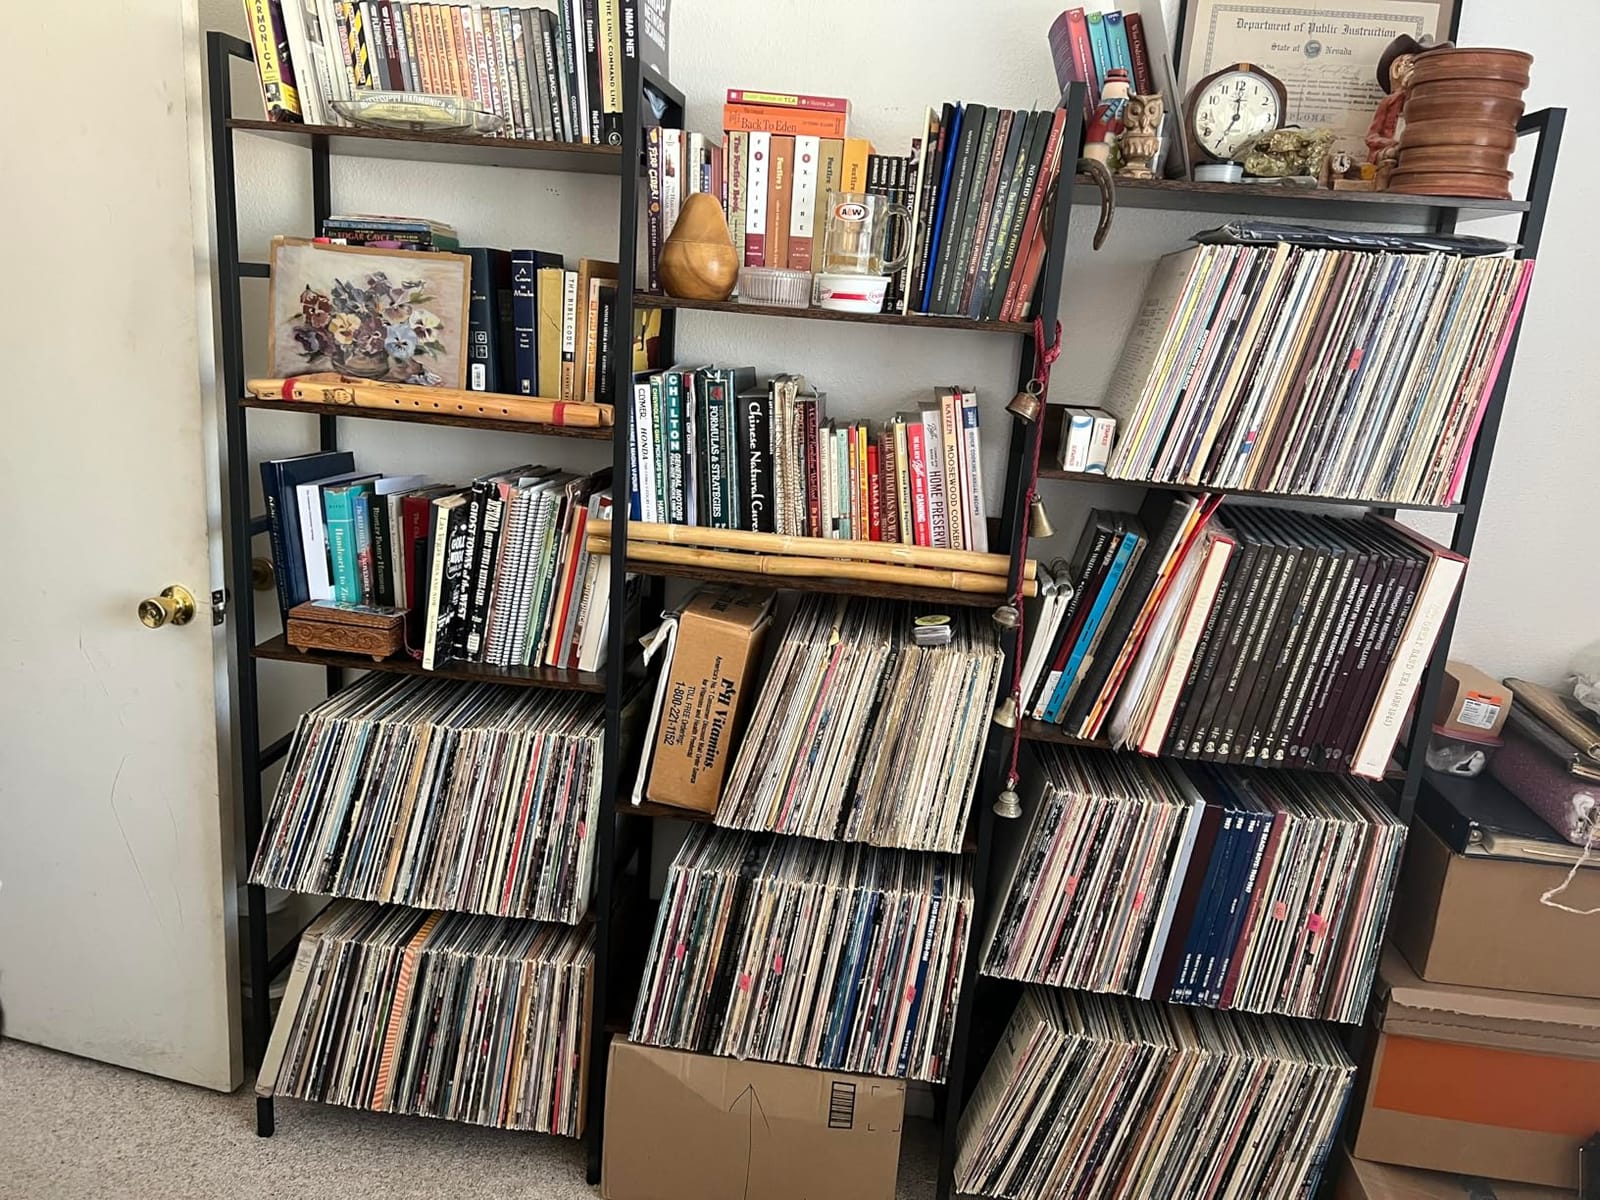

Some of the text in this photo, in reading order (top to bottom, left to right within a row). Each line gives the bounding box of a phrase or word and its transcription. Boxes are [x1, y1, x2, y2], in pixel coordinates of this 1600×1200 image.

[585, 19, 595, 52] Essentials
[624, 7, 634, 37] NMAP
[1236, 17, 1396, 38] Department of Public Instruction
[1271, 42, 1291, 52] State
[1325, 46, 1352, 56] Nevada
[607, 45, 615, 87] COMMAND
[1235, 80, 1246, 92] 12
[741, 118, 761, 129] Back
[776, 121, 797, 133] Eden
[999, 179, 1008, 193] The
[1003, 163, 1035, 269] NO GRID SURVIVAL PROJECTS
[979, 240, 993, 271] Backyard
[637, 388, 648, 460] CLYMER HONDA
[668, 375, 682, 450] CHILTON
[748, 401, 763, 449] Chinese
[709, 405, 719, 454] FORMULAS
[884, 437, 894, 453] THE
[944, 403, 959, 507] KATZEN MOOSEWOOD
[673, 452, 683, 521] GENERAL MOTORS
[711, 463, 721, 517] STRATEGIES
[749, 450, 764, 498] Natural
[886, 472, 896, 492] THAT
[928, 470, 942, 497] HOME
[482, 498, 500, 532] NEVADA
[887, 492, 897, 511] HAS
[916, 493, 926, 522] CANNING
[462, 536, 475, 569] TOWNS
[456, 592, 468, 620] WEST
[1365, 583, 1383, 617] NASHVILLE
[1387, 584, 1405, 615] MIDNIGHT
[1393, 590, 1415, 637] FOR THE GOOD
[1321, 577, 1360, 668] SMOKEY MOUNTAIN MEMORIES
[1336, 583, 1368, 656] TWILIGHT IN TENNESSEE
[1373, 621, 1389, 650] MEMPHIS
[1355, 621, 1379, 671] HANK WILLIAMS
[685, 684, 696, 702] TOLL
[682, 702, 692, 719] FREE
[703, 709, 728, 769] Vitamins
[1257, 832, 1268, 852] BEACH
